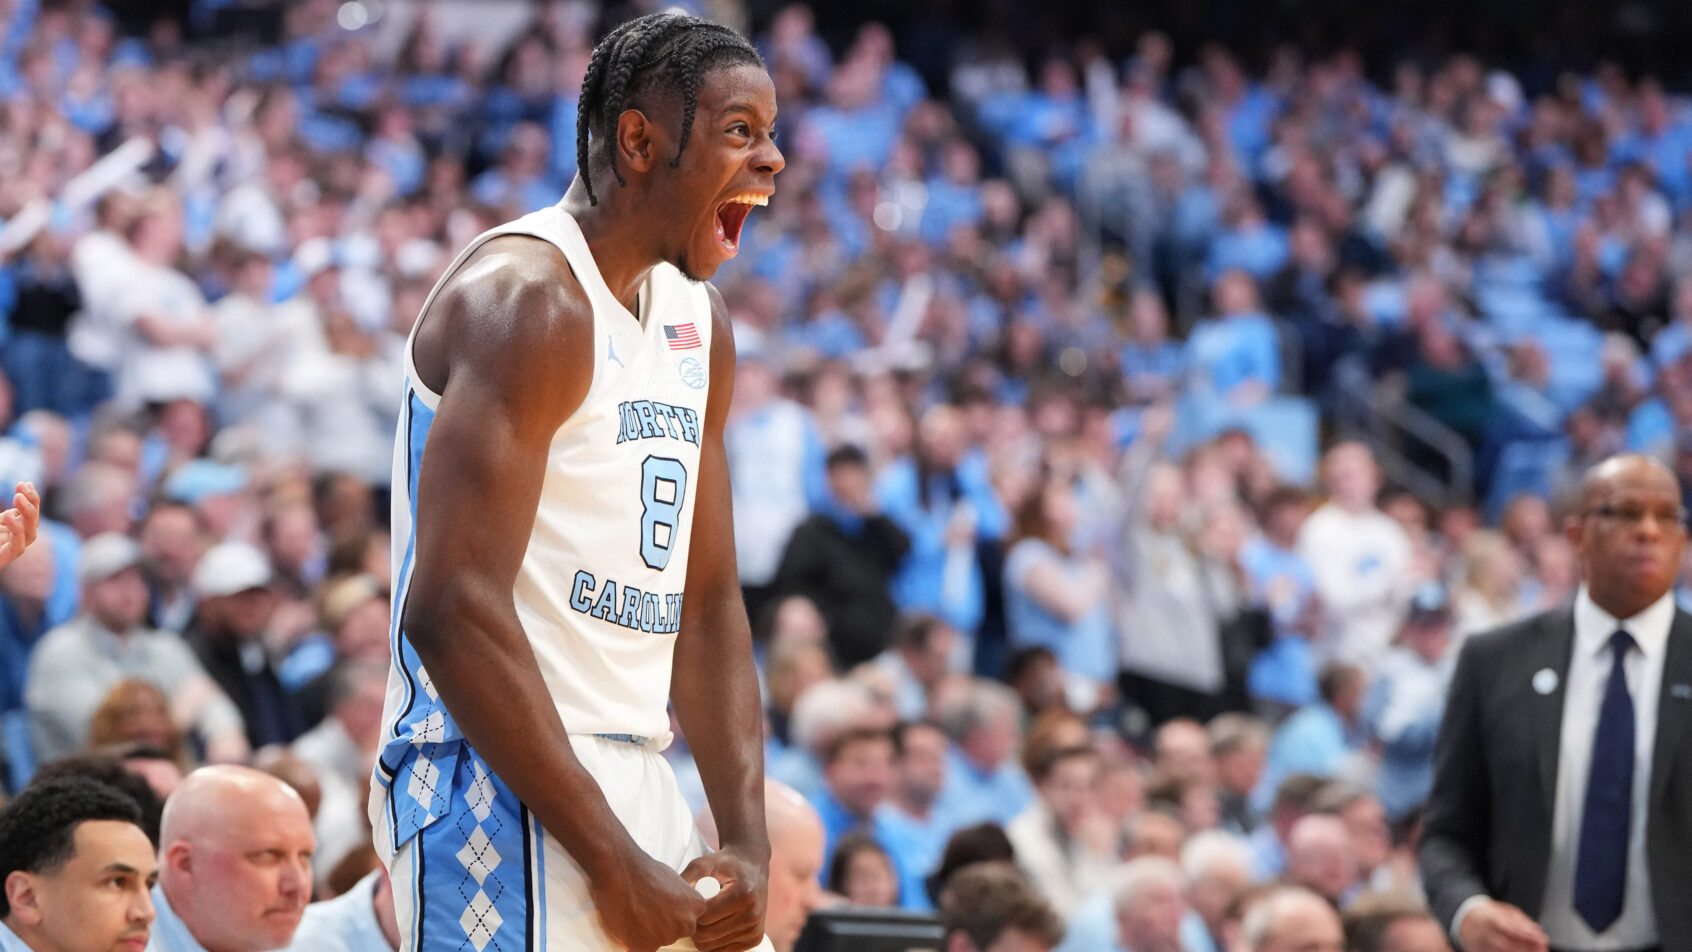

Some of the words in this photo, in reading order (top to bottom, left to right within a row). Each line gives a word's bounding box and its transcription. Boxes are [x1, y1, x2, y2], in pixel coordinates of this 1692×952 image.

[616, 400, 700, 448] NORTH
[640, 454, 687, 572] 8
[569, 569, 684, 634] CAROLIN
